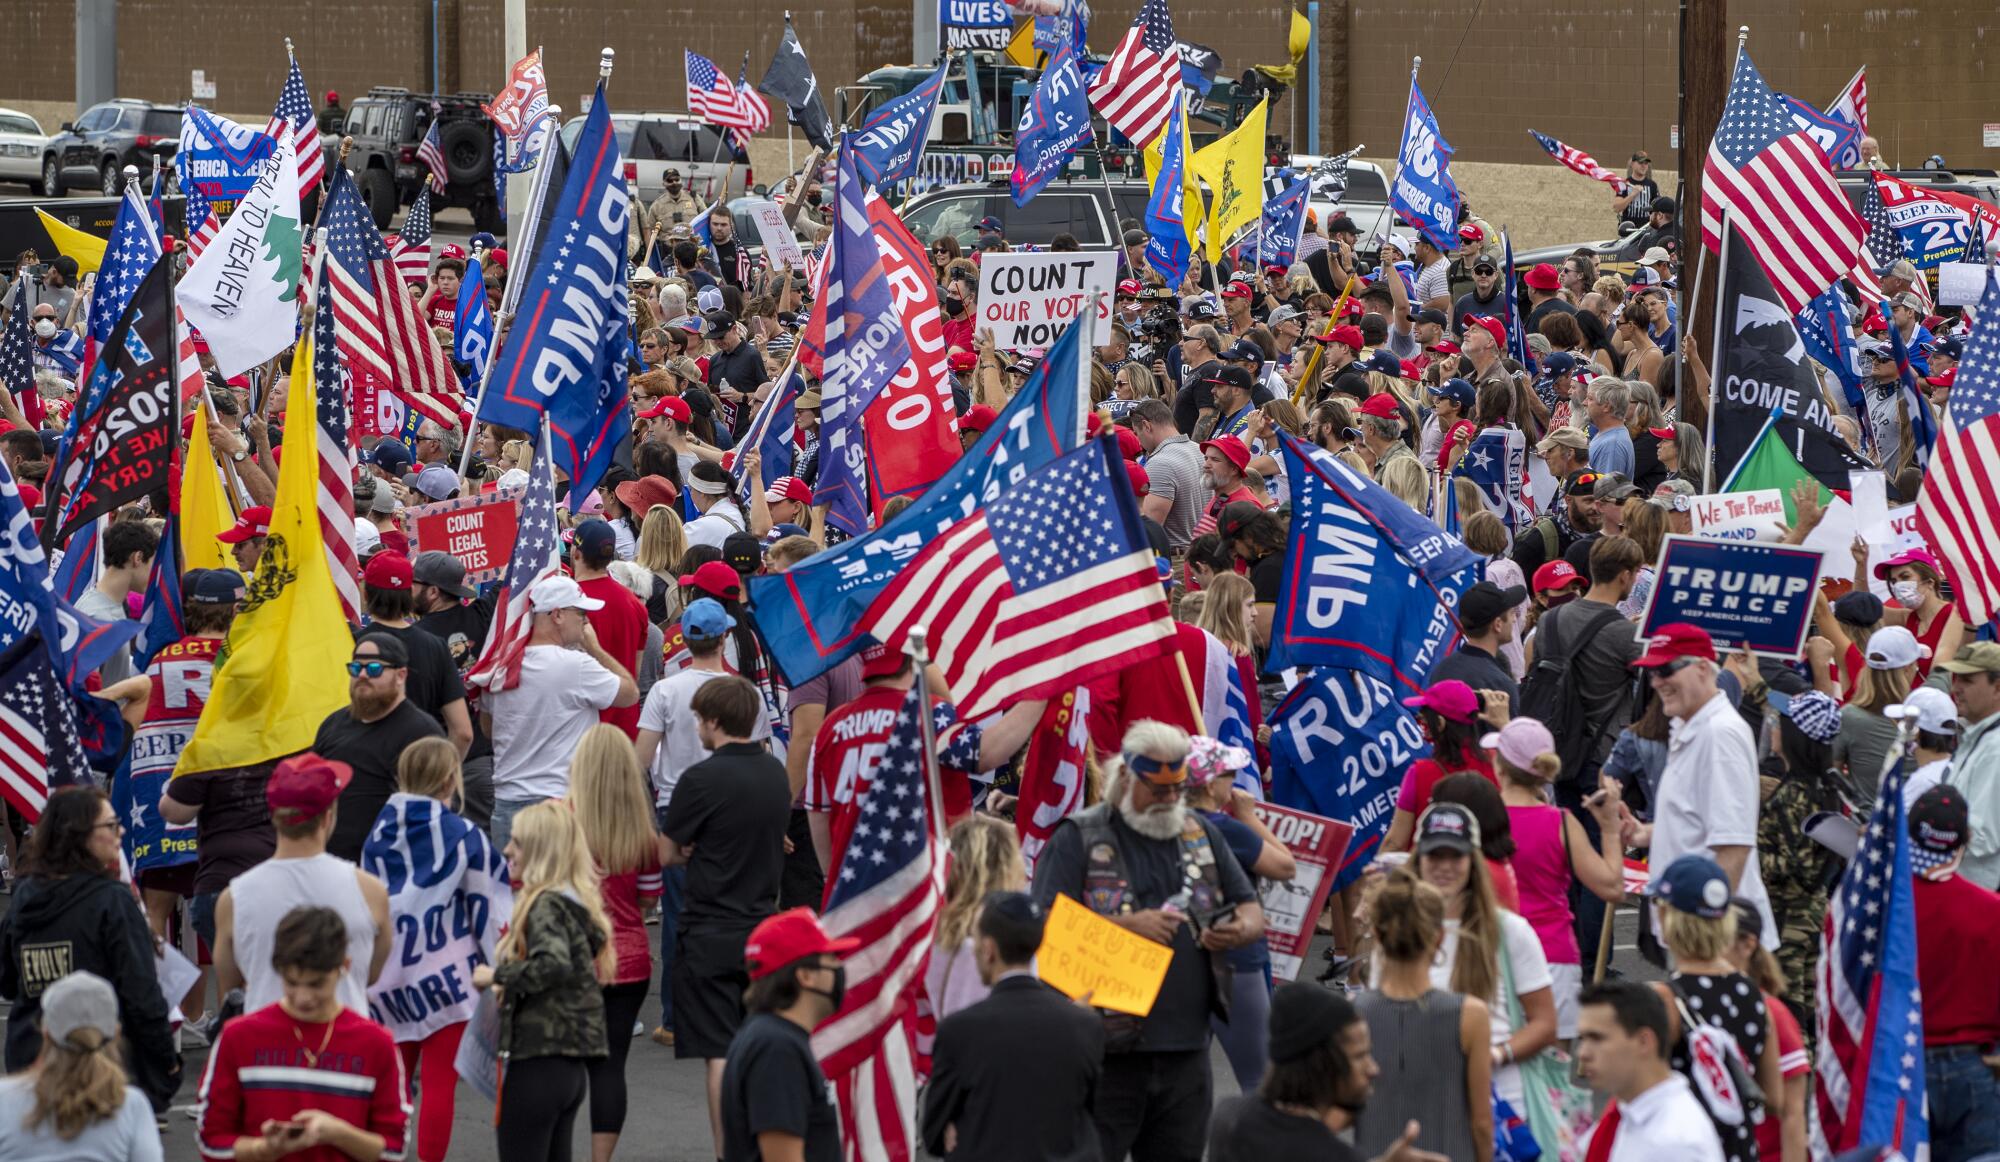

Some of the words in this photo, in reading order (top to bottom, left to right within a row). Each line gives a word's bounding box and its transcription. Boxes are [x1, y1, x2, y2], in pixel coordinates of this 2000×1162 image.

[950, 1, 1006, 23] LIVES
[947, 27, 1012, 49] MATTER
[241, 200, 268, 229] TO
[1889, 205, 1930, 223] KEEP
[1921, 221, 1973, 250] 20
[1923, 246, 1965, 262] Presiden
[211, 228, 260, 316] HEAVEN
[991, 260, 1095, 296] COUNT
[986, 300, 1031, 322] OUR
[1044, 291, 1109, 320] VOTS
[1199, 304, 1213, 314] USA
[875, 234, 959, 433] TRUM
[1726, 375, 1800, 416] COME
[1803, 398, 1844, 439] AN
[1510, 447, 1524, 501] KEEP
[447, 511, 485, 534] COUNT
[449, 532, 486, 554] LEGAL
[1408, 535, 1444, 565] EEP
[456, 550, 489, 571] OTES
[1667, 565, 1809, 597] TRUMP
[1672, 590, 1790, 614] PENCE
[1703, 611, 1741, 622] AMERICA
[1742, 614, 1773, 625] GREAT!
[832, 708, 897, 744] TRUMP
[833, 742, 889, 809] 45
[1351, 785, 1401, 837] AMER
[134, 843, 151, 858] or
[161, 837, 198, 853] Pres
[24, 946, 68, 981] EVOLVE
[1046, 943, 1143, 1001] TRIUMPH
[380, 963, 469, 1025] MORE
[255, 1048, 366, 1074] HILFGER
